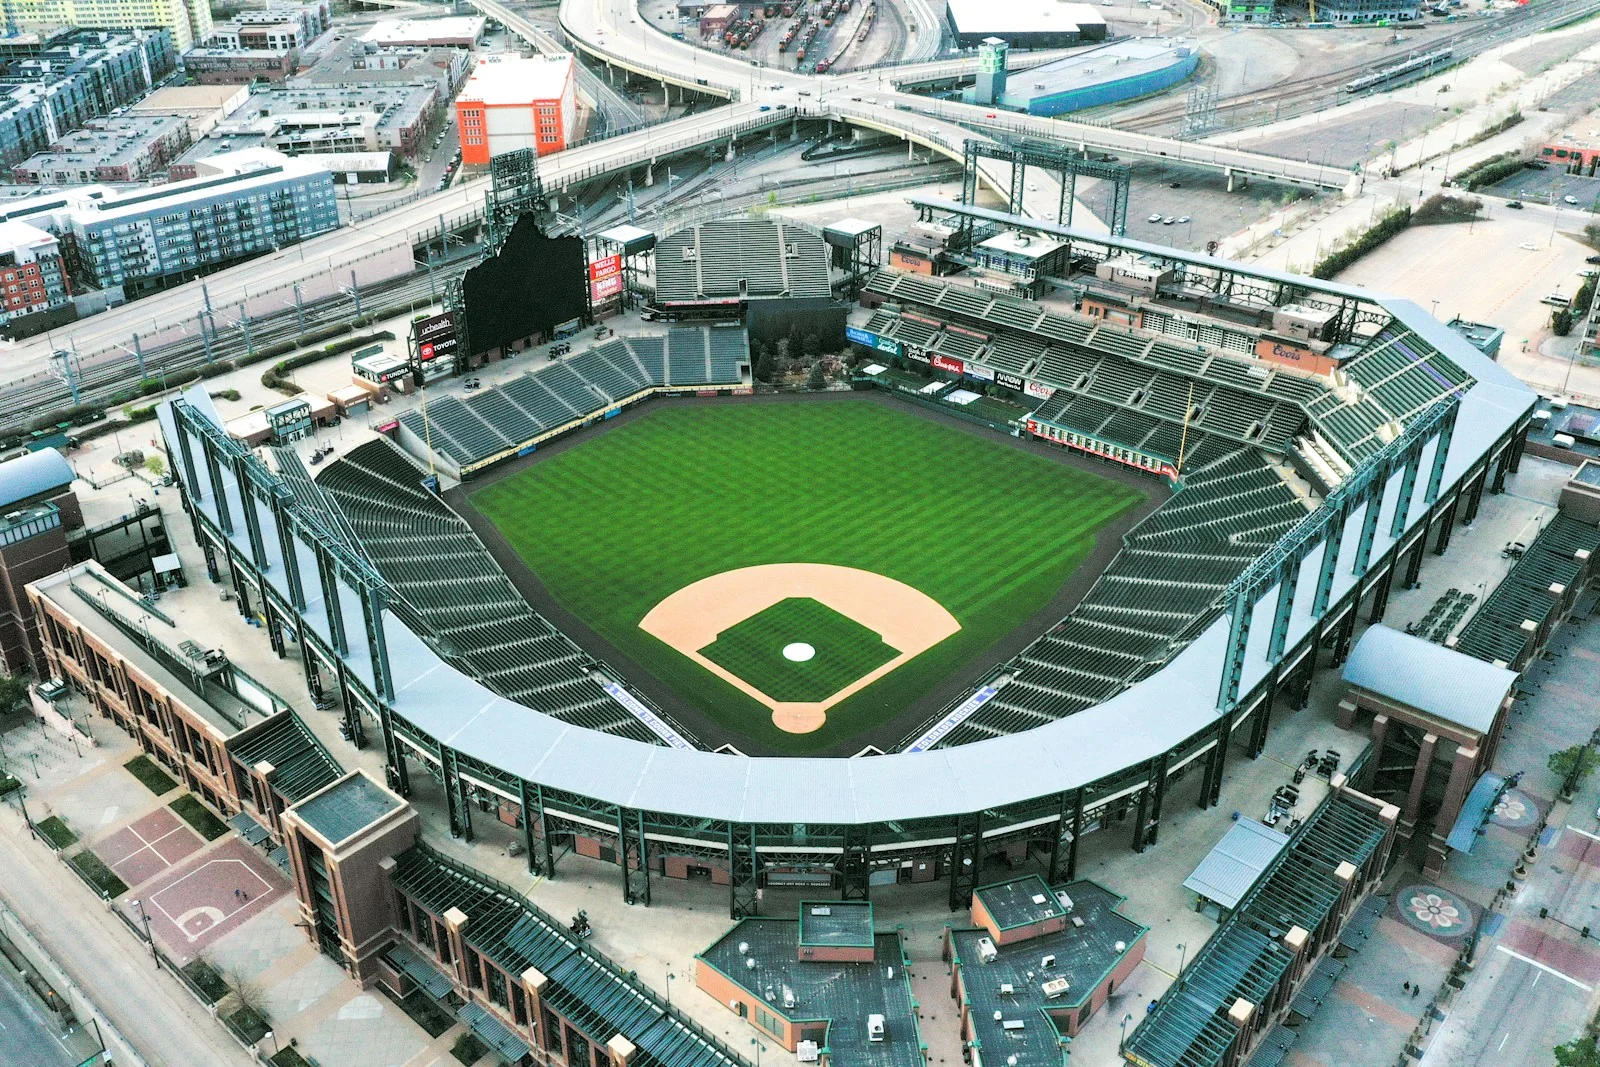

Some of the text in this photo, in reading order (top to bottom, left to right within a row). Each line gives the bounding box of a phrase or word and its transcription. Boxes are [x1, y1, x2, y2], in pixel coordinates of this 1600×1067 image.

[594, 257, 616, 269] WELLS
[595, 265, 616, 278] FARGO
[596, 276, 617, 291] KING
[421, 318, 451, 334] uchealth
[433, 338, 457, 352] TOYOTA
[877, 343, 898, 354] dental
[1273, 343, 1300, 361] Coors
[907, 352, 931, 363] Colorado
[386, 367, 409, 380] TUNDRA
[996, 372, 1021, 386] ARROW
[1029, 380, 1053, 396] Coors
[615, 692, 643, 716] WELCOME
[650, 720, 673, 739] COORS
[916, 699, 981, 750] COLORADO ROCKIES
